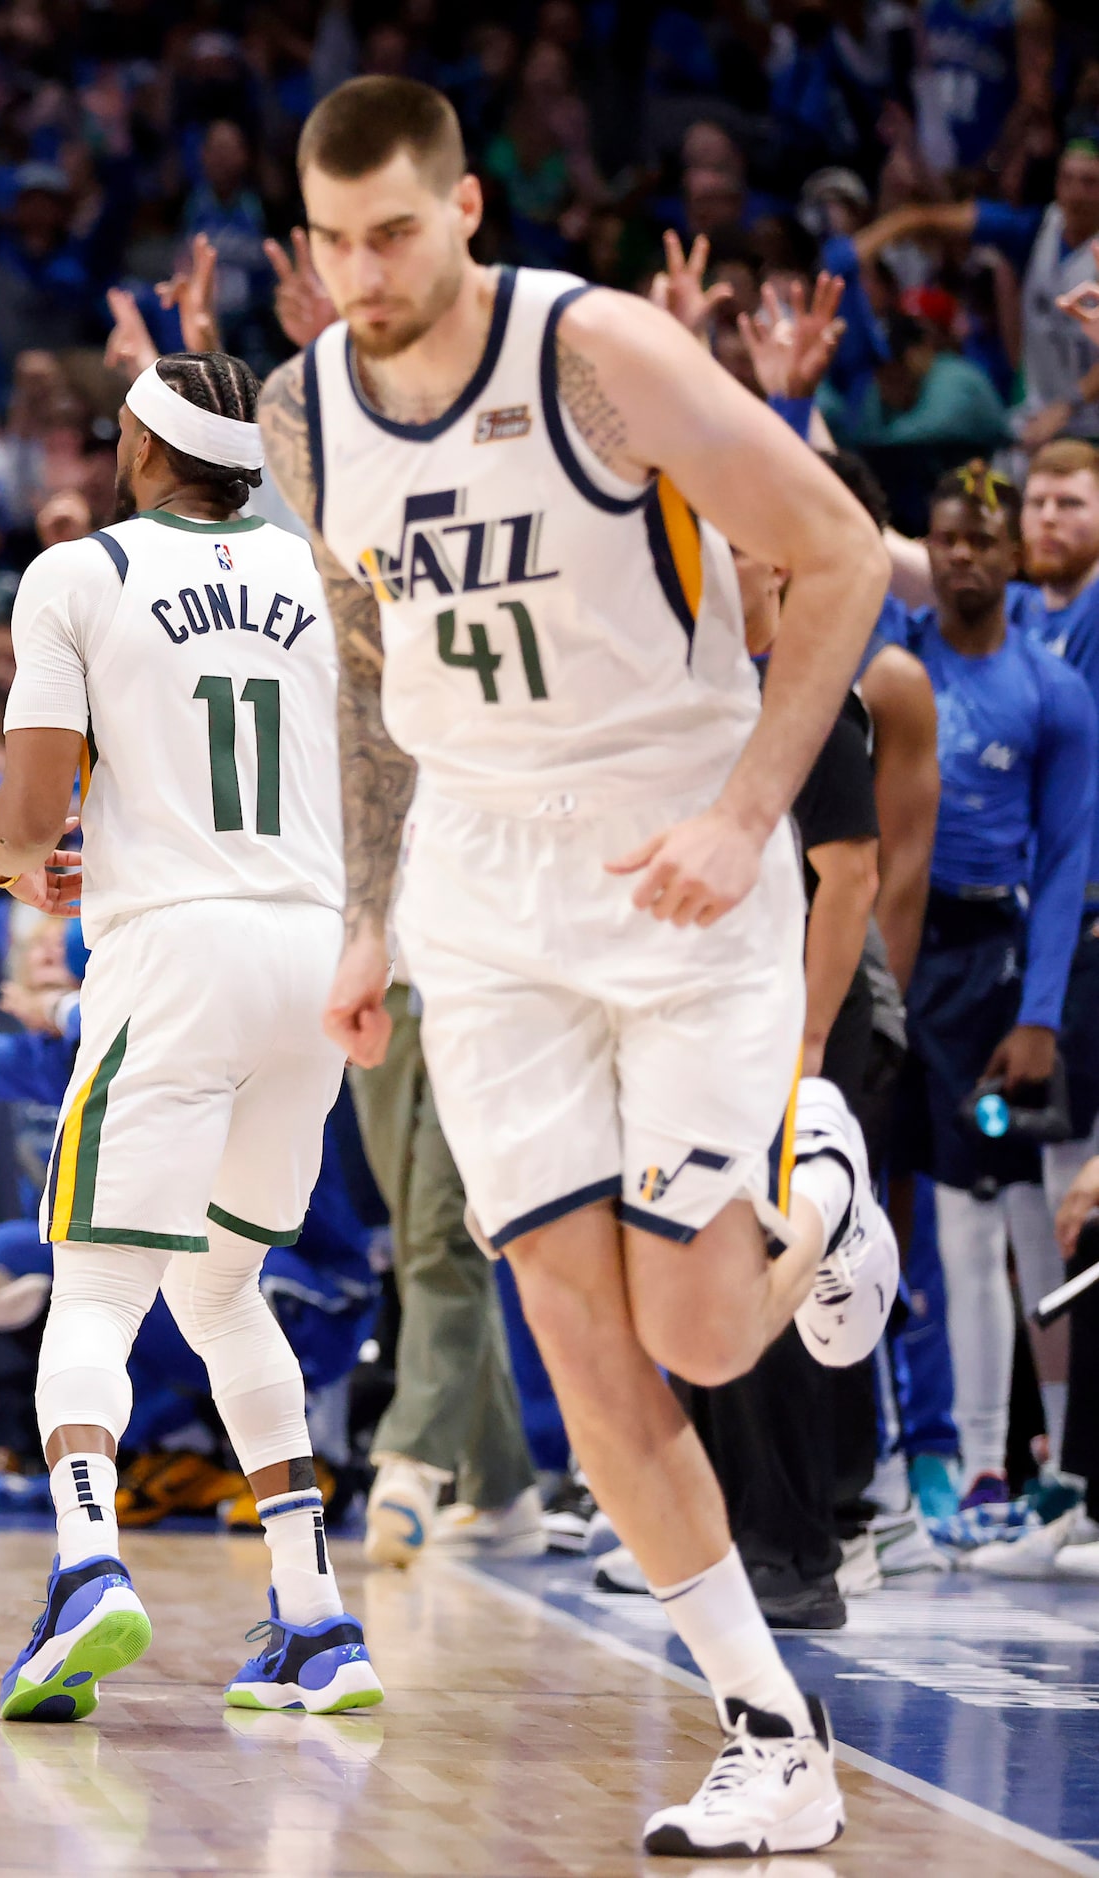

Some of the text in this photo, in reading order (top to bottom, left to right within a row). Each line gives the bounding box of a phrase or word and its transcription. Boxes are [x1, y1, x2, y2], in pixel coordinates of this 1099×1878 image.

[357, 487, 561, 603] JAZZ
[151, 583, 317, 651] CONLEY
[436, 600, 549, 704] 41
[192, 675, 280, 837] 11
